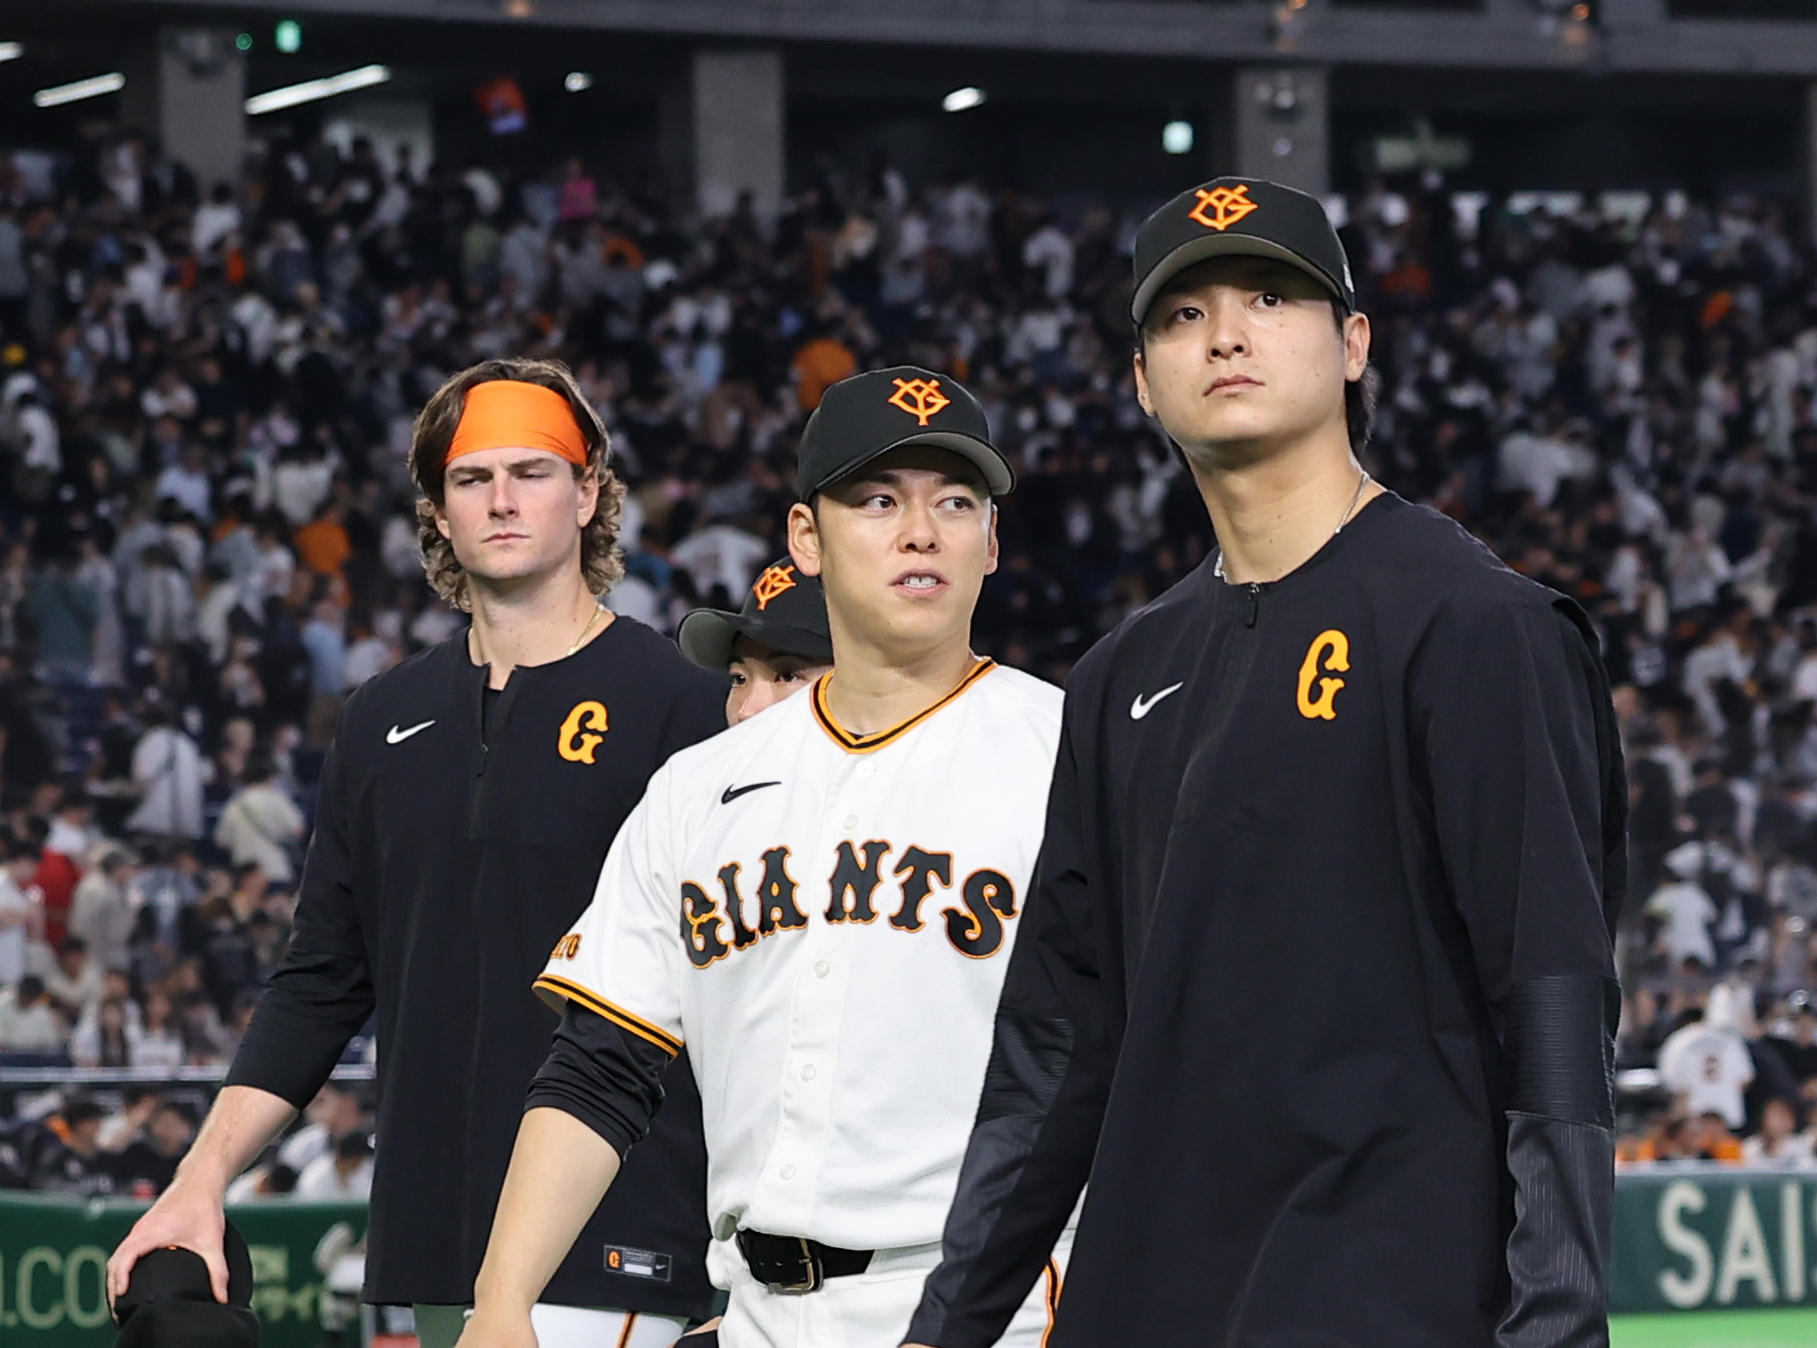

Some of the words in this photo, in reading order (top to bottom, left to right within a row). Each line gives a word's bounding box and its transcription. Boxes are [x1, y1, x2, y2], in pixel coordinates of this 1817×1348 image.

[1296, 628, 1352, 721] G
[557, 700, 610, 765] G
[679, 839, 1020, 970] GIANTS
[1656, 1178, 1817, 1309] SAI
